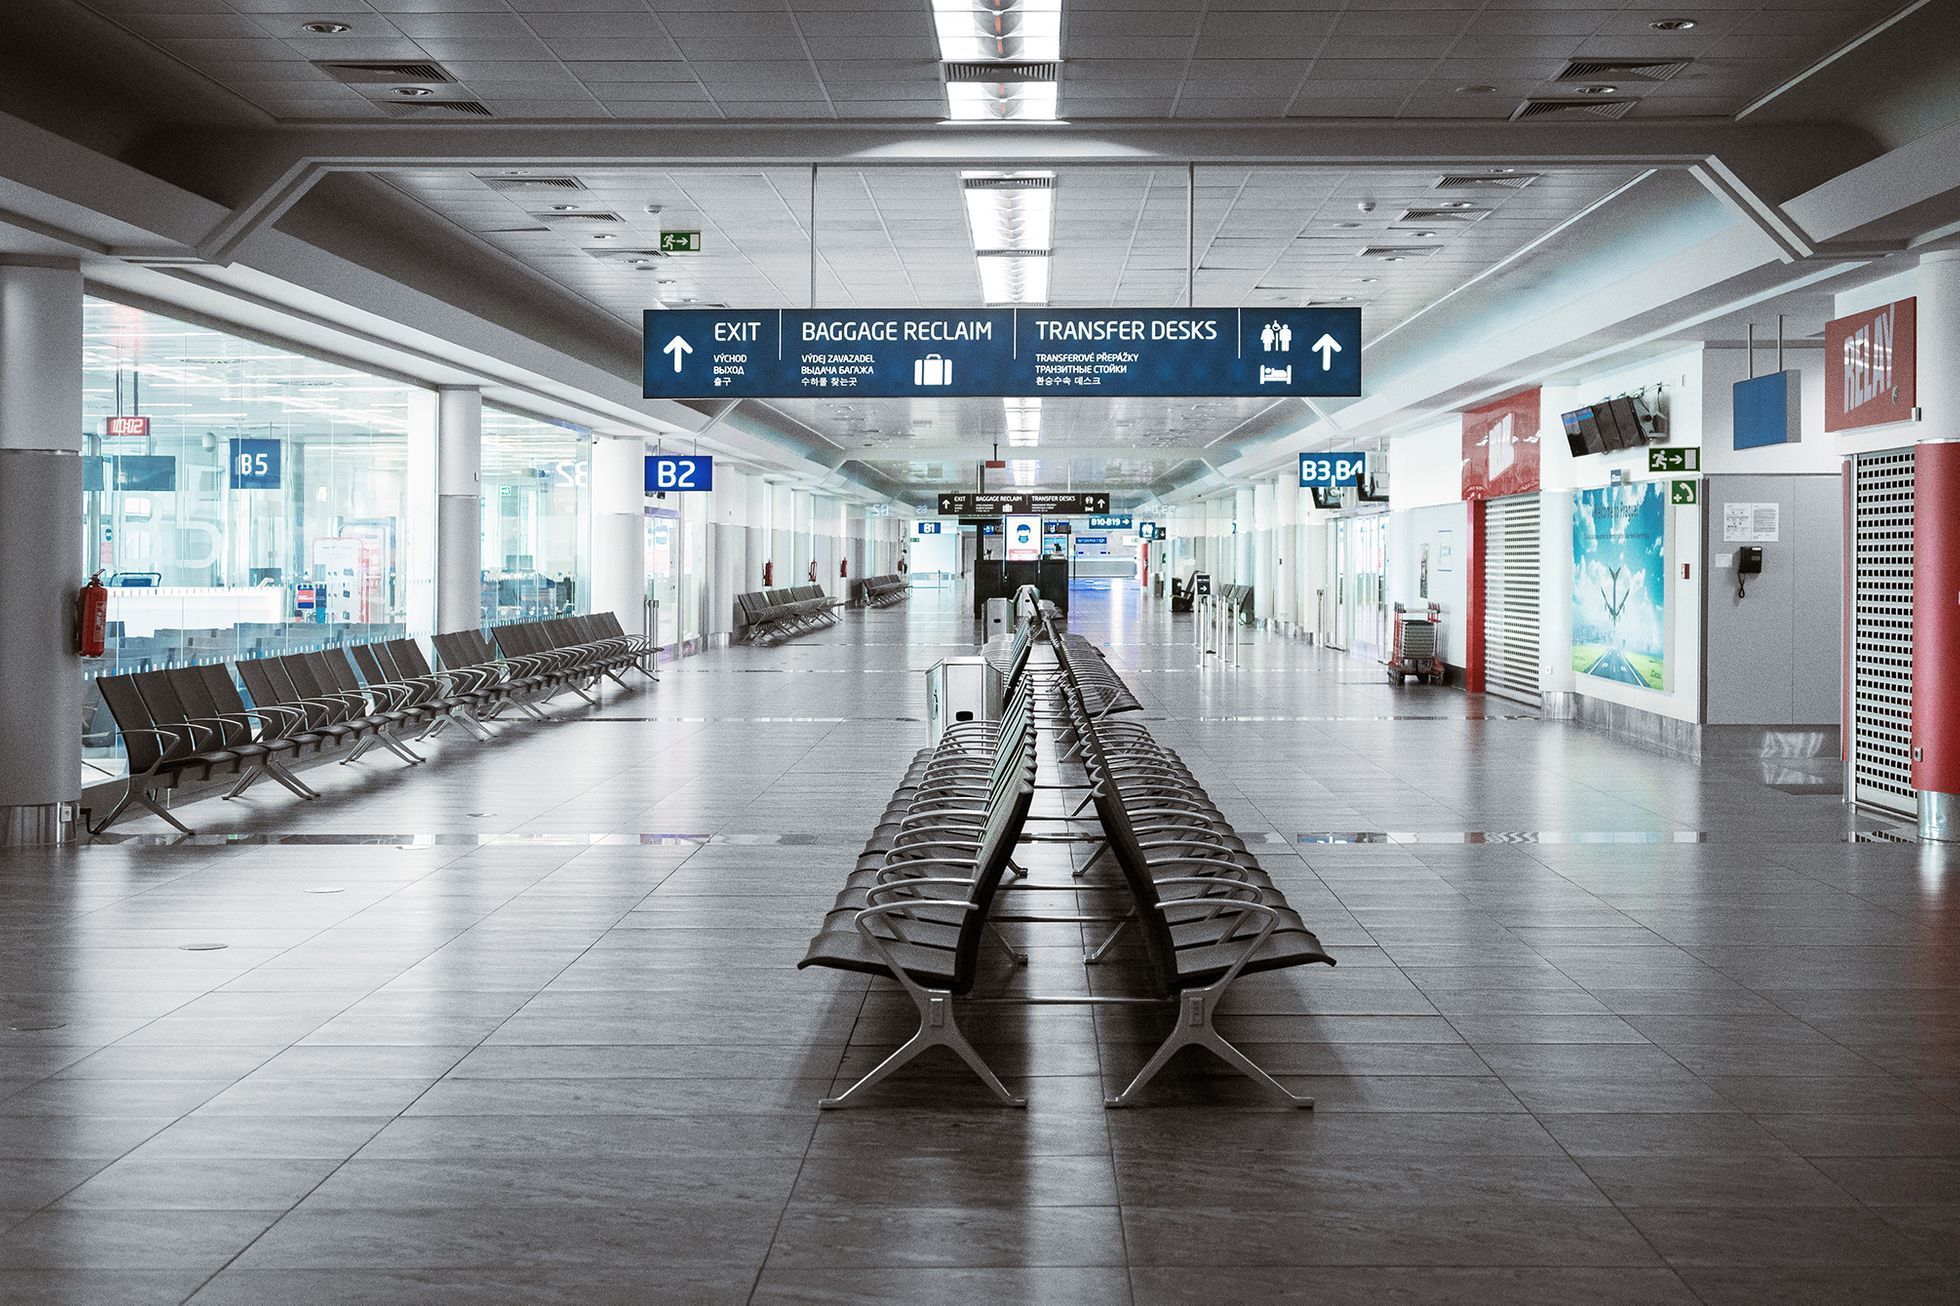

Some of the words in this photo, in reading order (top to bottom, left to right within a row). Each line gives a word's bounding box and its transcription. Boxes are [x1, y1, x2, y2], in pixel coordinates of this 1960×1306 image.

[715, 321, 762, 342] EXIT
[803, 321, 898, 342] BAGGAGE
[904, 321, 992, 341] RECLAIM
[1036, 320, 1146, 341] TRANSFER
[1152, 320, 1218, 341] DESKS
[714, 353, 748, 363] VÝCHOD
[802, 353, 827, 364] VÝDEJ
[828, 354, 876, 363] ZAVAZADEL
[1036, 352, 1095, 363] TRANSFEROVÉ
[1096, 352, 1140, 363] PŘEPÁŽKY
[1843, 302, 1895, 415] RELAY
[714, 366, 745, 376] ВЫХОД
[801, 366, 838, 376] ВЫДАЧА
[839, 366, 875, 375] БАГАЖА
[1035, 365, 1093, 374] ТРАНЗИТНЫЕ
[1094, 364, 1128, 374] СТОЙКИ
[714, 377, 732, 387] 출구
[801, 377, 829, 387] 수하물
[238, 453, 268, 475] B5
[658, 461, 696, 488] B2
[923, 523, 935, 533] B1
